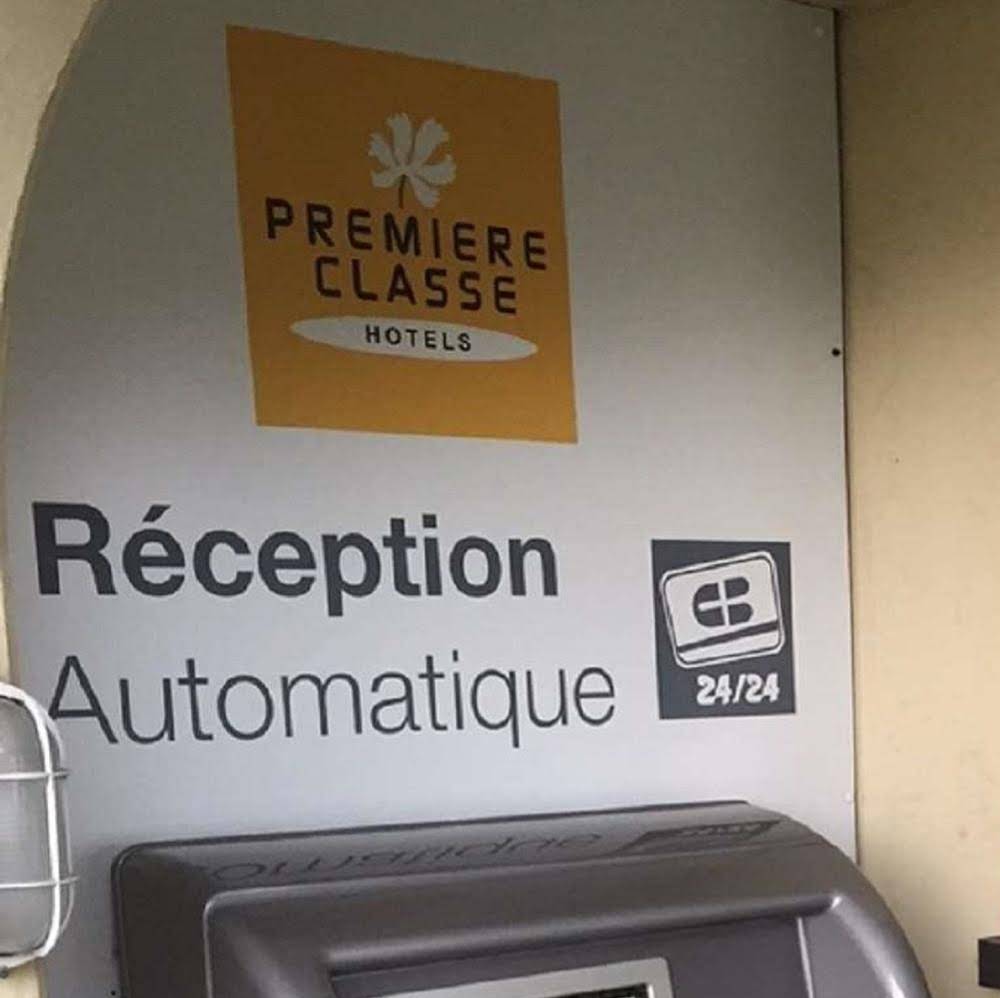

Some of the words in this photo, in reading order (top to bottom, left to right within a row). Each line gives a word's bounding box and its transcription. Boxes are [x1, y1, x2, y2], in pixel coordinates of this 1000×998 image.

[265, 197, 547, 271] PREMIERE
[315, 256, 517, 315] CLASSE
[365, 324, 472, 353] HOTELS
[32, 501, 559, 617] Réception
[47, 650, 616, 749] Automatique
[696, 672, 780, 706] 24/24
